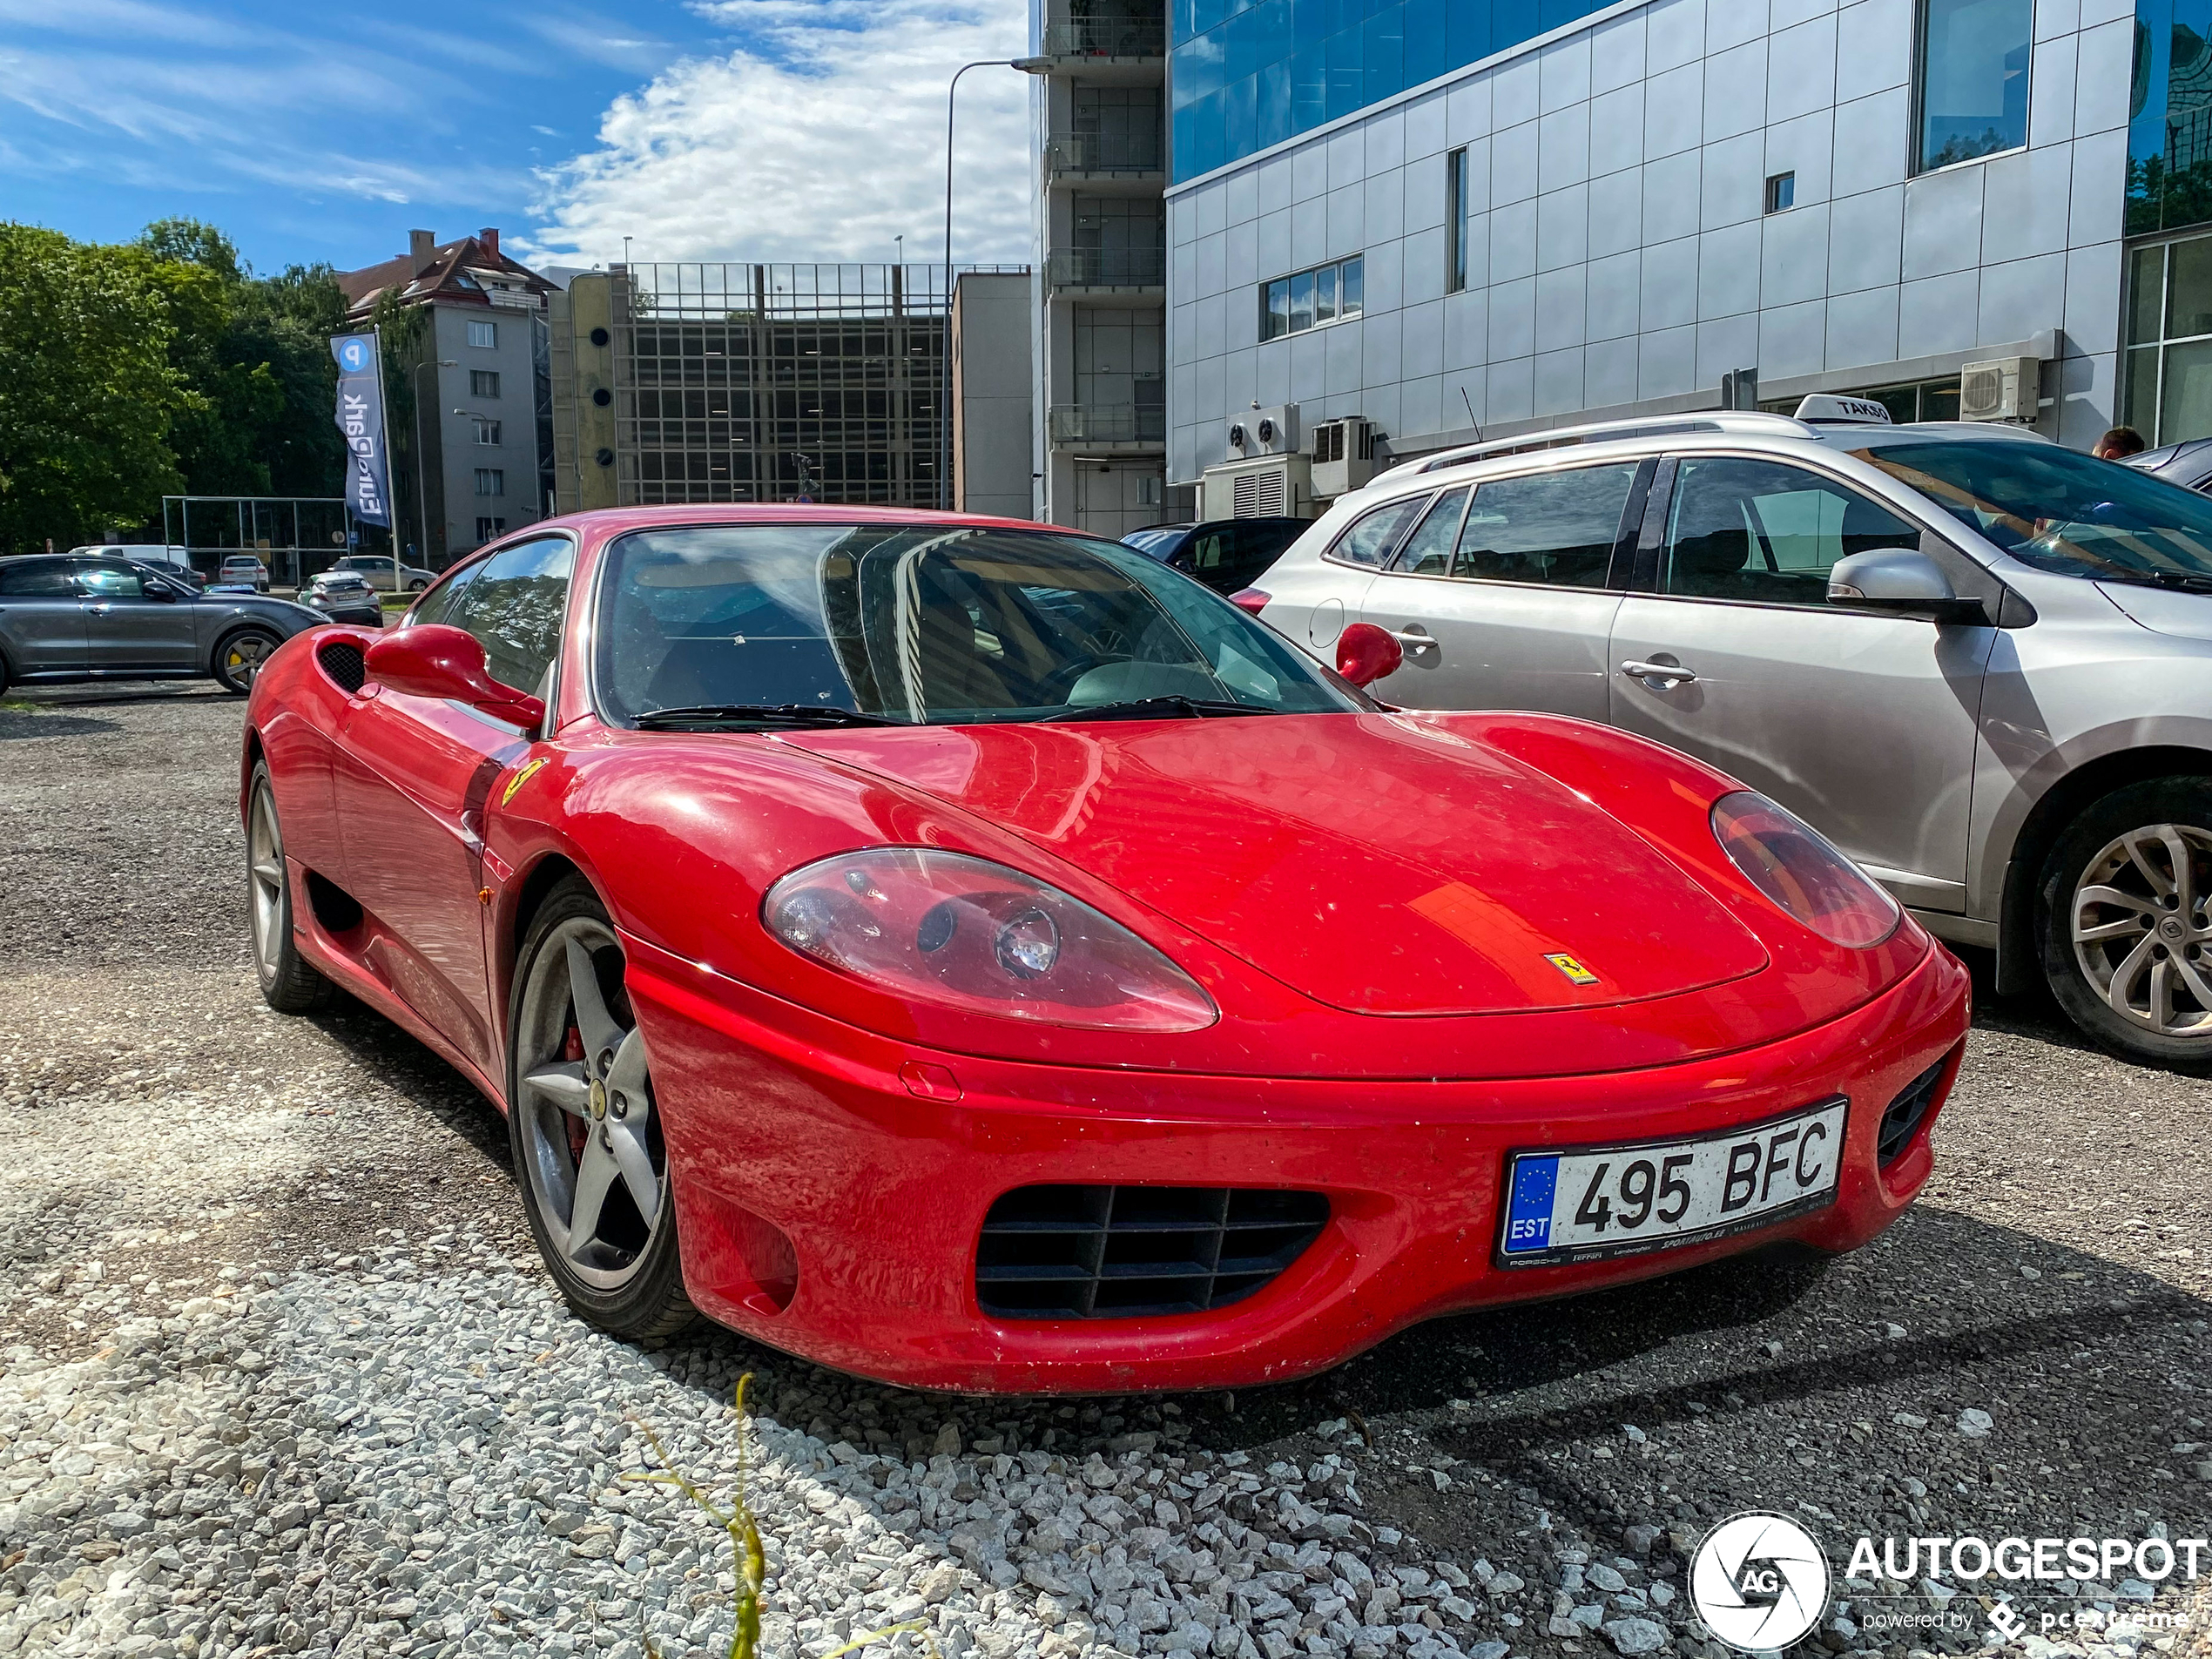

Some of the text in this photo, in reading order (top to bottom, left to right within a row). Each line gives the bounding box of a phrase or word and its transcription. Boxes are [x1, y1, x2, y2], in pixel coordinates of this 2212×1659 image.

[1836, 401, 1889, 421] TAKSO
[1574, 1122, 1827, 1232] 495 BFC
[1511, 1217, 1549, 1240] EST
[1509, 1257, 1561, 1266] PORSCHE
[1572, 1252, 1602, 1262] Ferrari
[1614, 1245, 1652, 1256] Lamborghini
[1661, 1228, 1727, 1250] SPORTAUTO.EE
